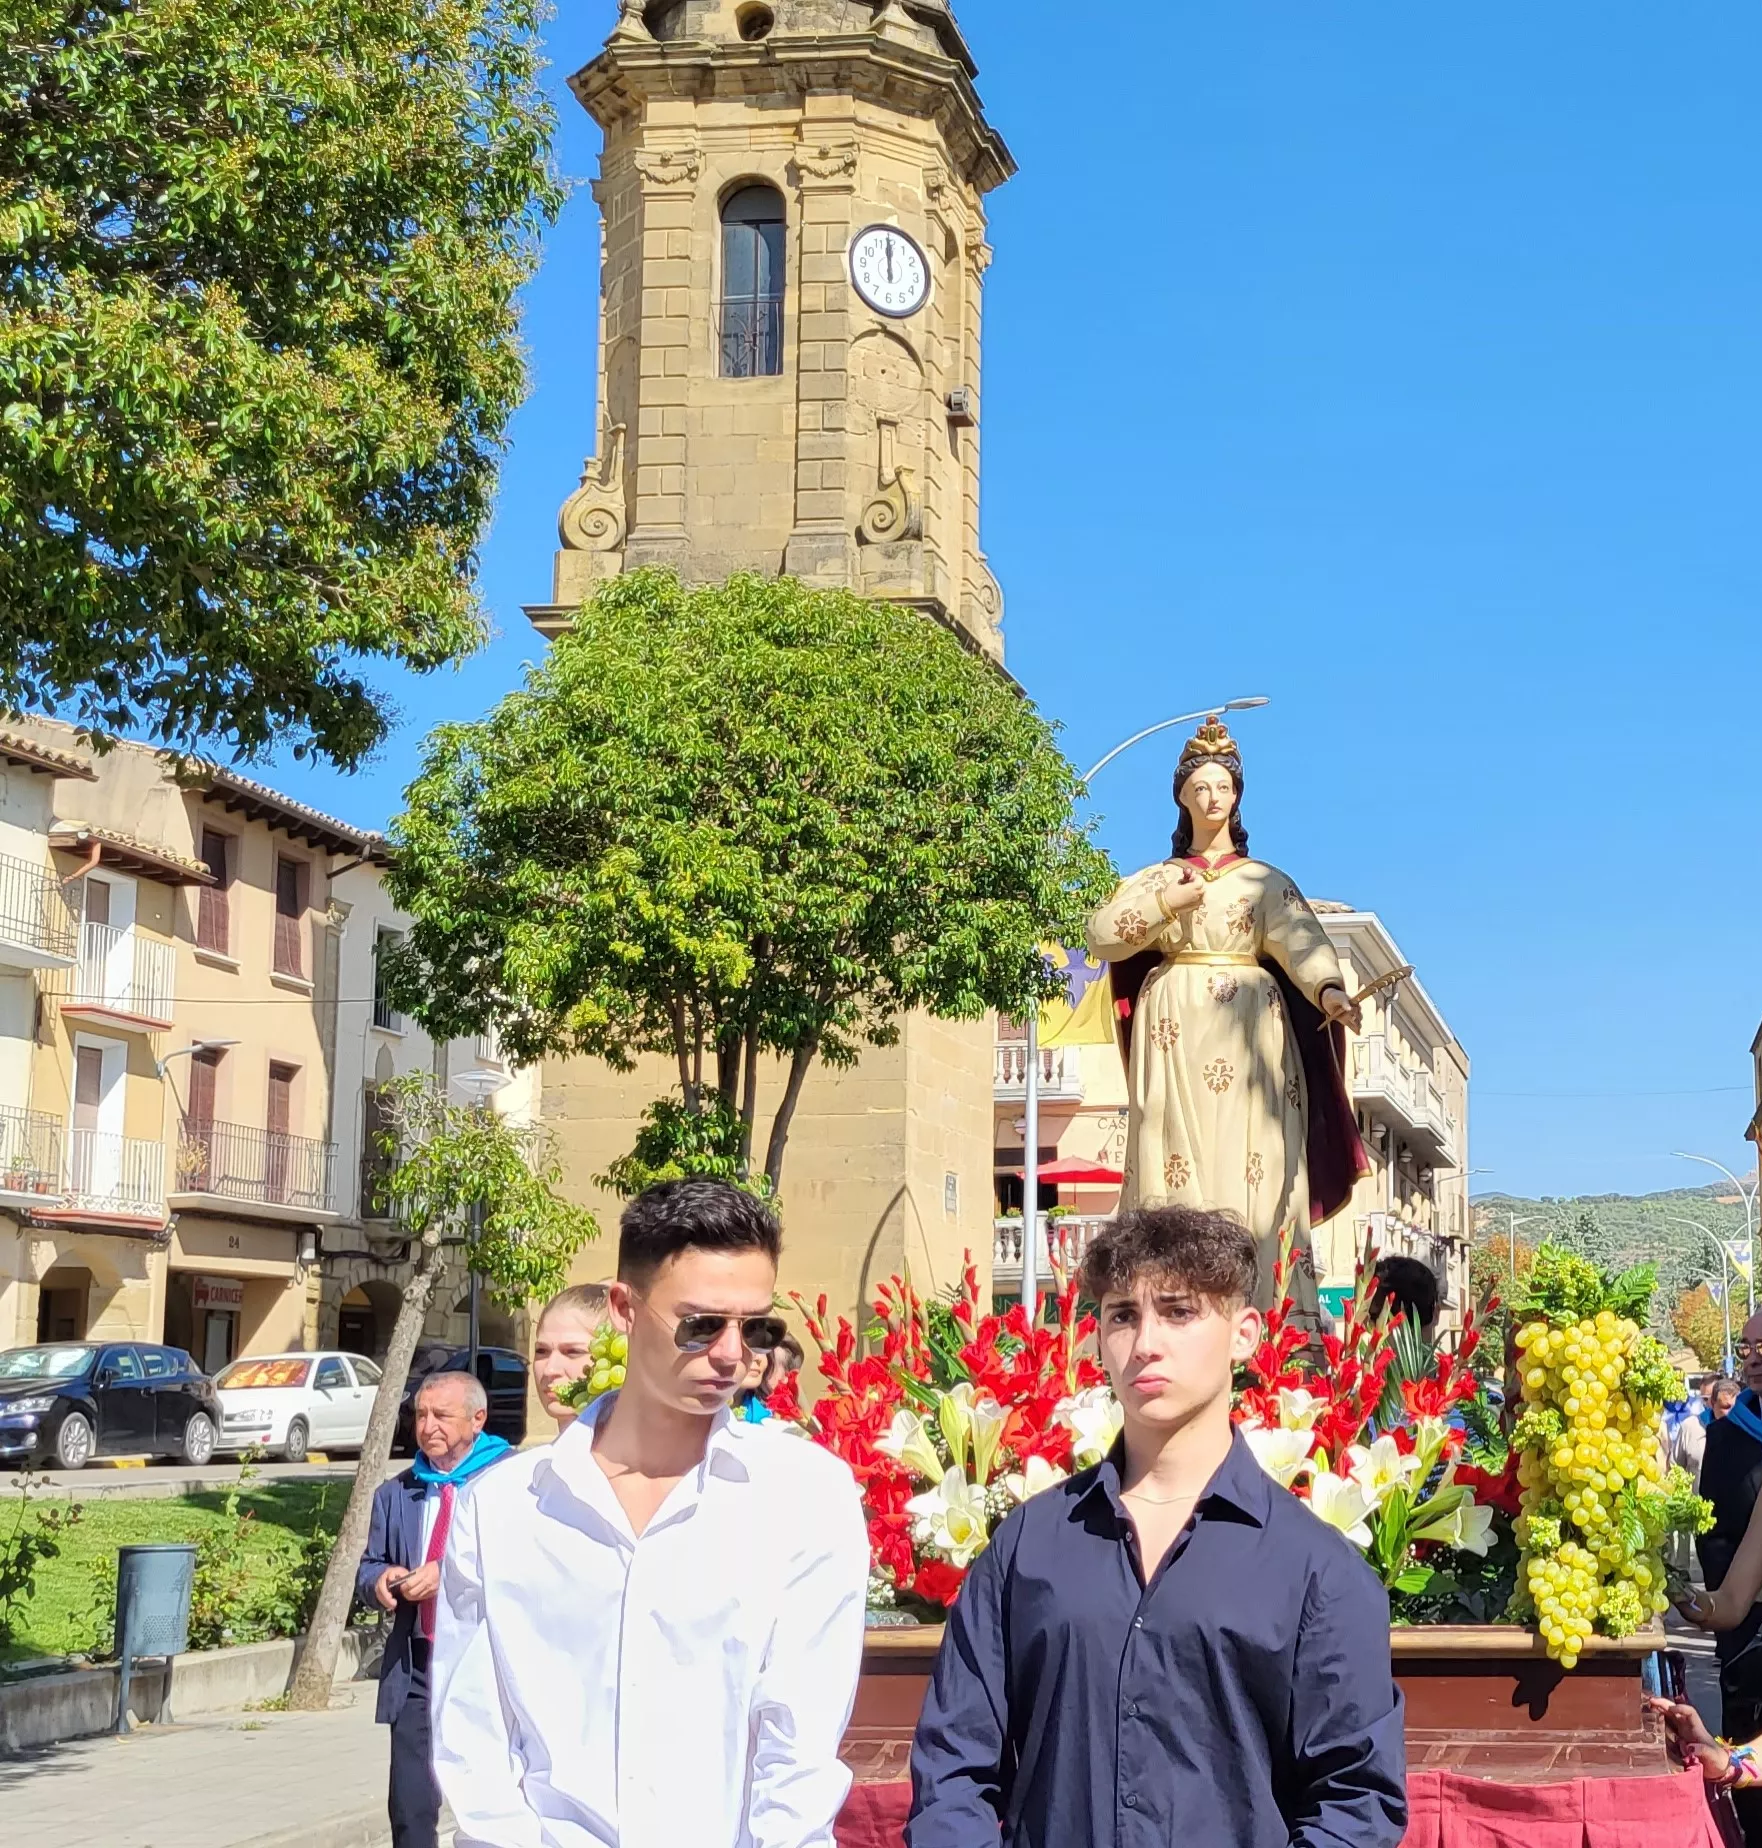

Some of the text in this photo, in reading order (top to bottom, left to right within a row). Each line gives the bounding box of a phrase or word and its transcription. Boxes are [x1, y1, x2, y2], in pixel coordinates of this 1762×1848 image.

[873, 238, 884, 250] 11
[863, 246, 875, 258] 10
[859, 257, 867, 268] 9
[908, 256, 916, 268] 2
[863, 272, 871, 283] 8
[912, 272, 920, 283] 3
[872, 284, 880, 296] 7
[907, 285, 915, 296] 4
[885, 292, 893, 304] 6
[898, 292, 906, 304] 5
[1097, 1117, 1127, 1130] CAS
[228, 1235, 240, 1249] 24
[210, 1286, 241, 1304] CARNICE
[1318, 1294, 1331, 1304] AL
